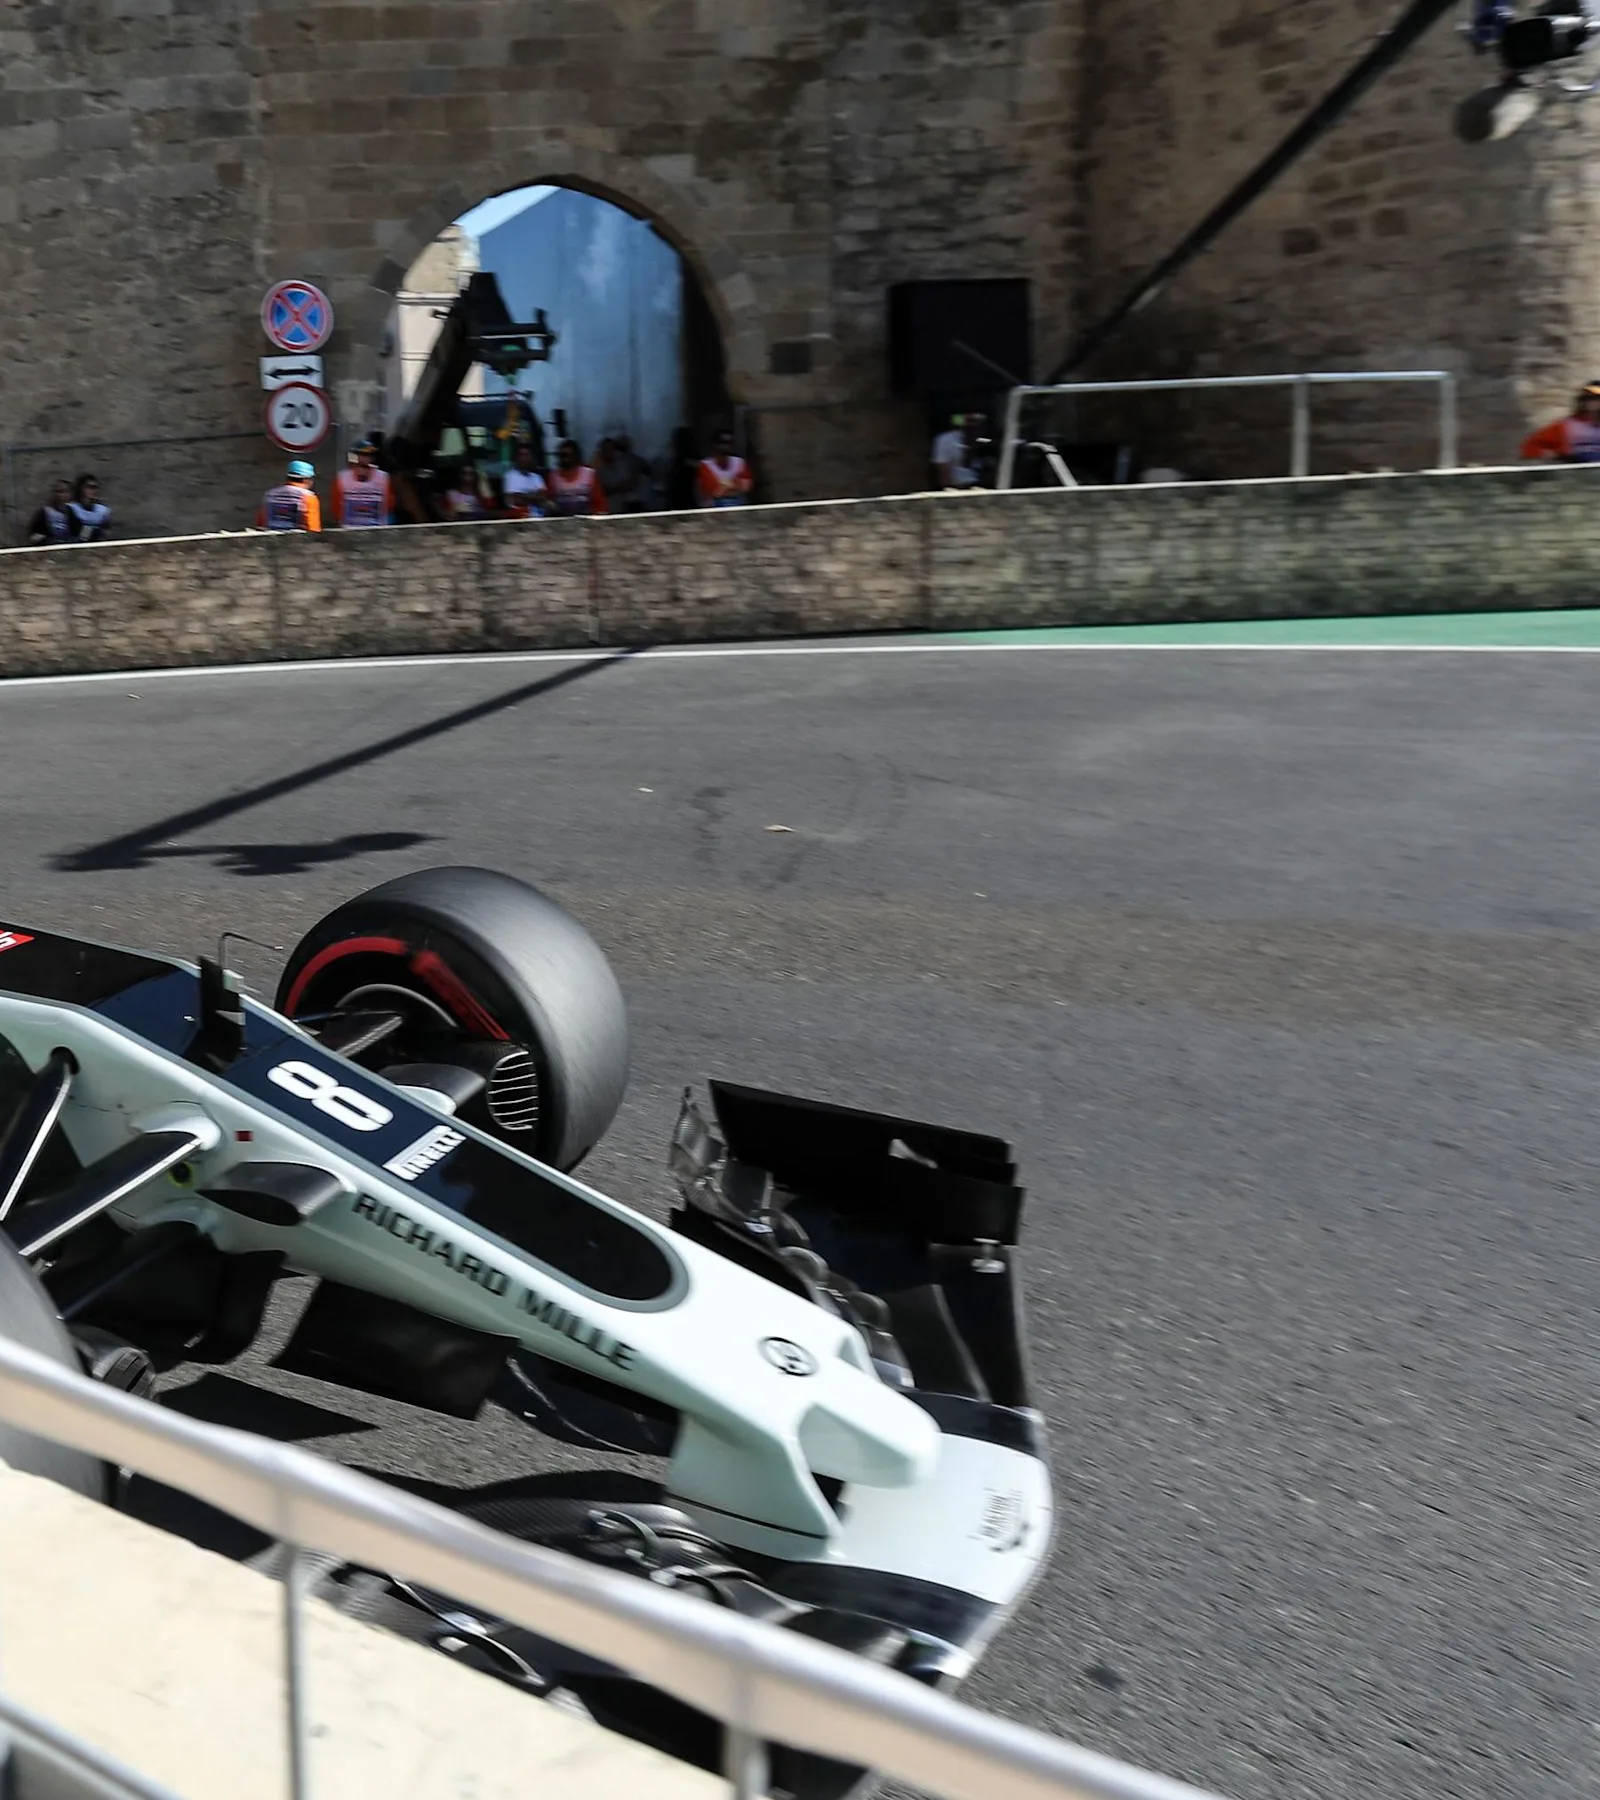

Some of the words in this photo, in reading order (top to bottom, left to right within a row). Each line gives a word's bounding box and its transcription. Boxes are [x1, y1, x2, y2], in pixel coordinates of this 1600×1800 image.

[279, 402, 320, 429] 20
[266, 1060, 395, 1132] 8
[351, 1193, 510, 1298] RICHARD
[516, 1287, 639, 1372] MILLE
